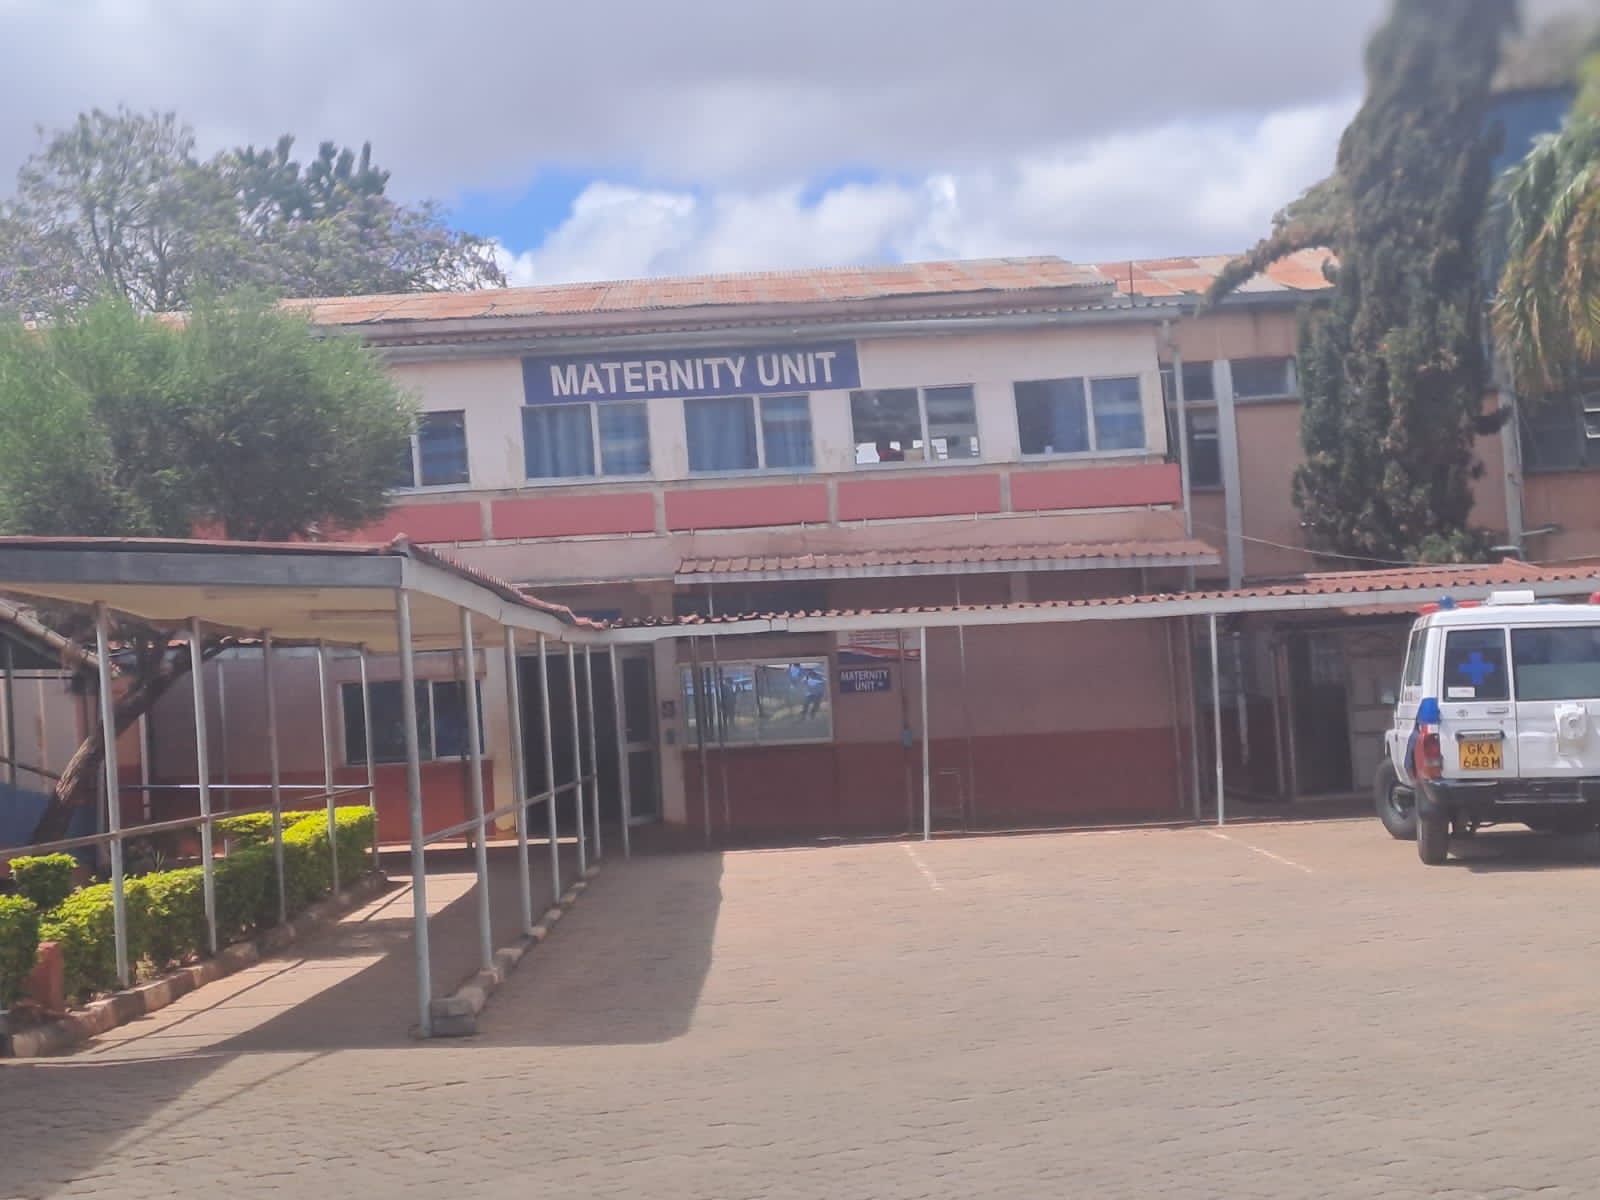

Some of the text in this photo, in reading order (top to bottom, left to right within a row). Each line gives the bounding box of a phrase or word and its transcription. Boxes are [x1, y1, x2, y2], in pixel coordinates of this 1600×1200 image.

[550, 352, 837, 397] MATERNITY UNIT
[840, 670, 889, 682] MATERNITY
[855, 680, 876, 692] UNIT
[1463, 756, 1501, 769] 648M
